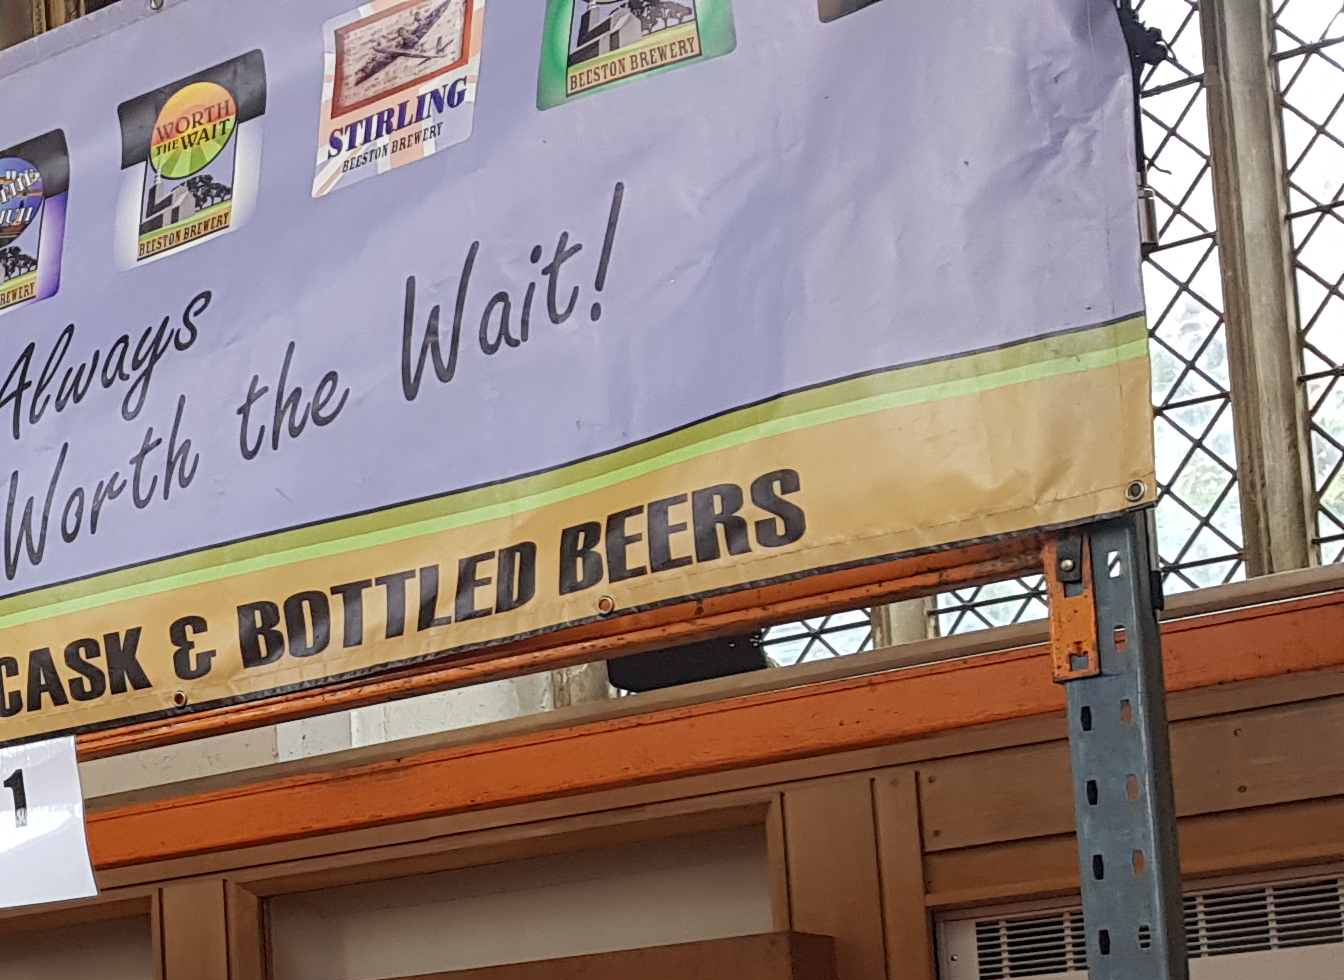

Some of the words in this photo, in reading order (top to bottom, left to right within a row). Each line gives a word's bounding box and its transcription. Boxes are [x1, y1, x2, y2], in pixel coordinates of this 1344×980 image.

[569, 58, 626, 91] BEESTON
[630, 37, 697, 71] BREWERY
[155, 138, 179, 156] THE
[181, 118, 230, 149] WAIT
[156, 99, 230, 142] WORTH
[327, 77, 468, 158] STIRLING
[342, 143, 388, 173] BEESTON
[391, 122, 444, 154] BREWERY
[139, 228, 182, 256] BEESTON
[183, 212, 230, 240] BREWERY
[4, 394, 200, 581] Worth
[237, 342, 351, 460] the
[401, 181, 624, 401] Wait!
[169, 616, 218, 681] &
[237, 541, 537, 669] BOTTLED
[558, 468, 808, 596] BEERS
[3, 768, 28, 827] 1
